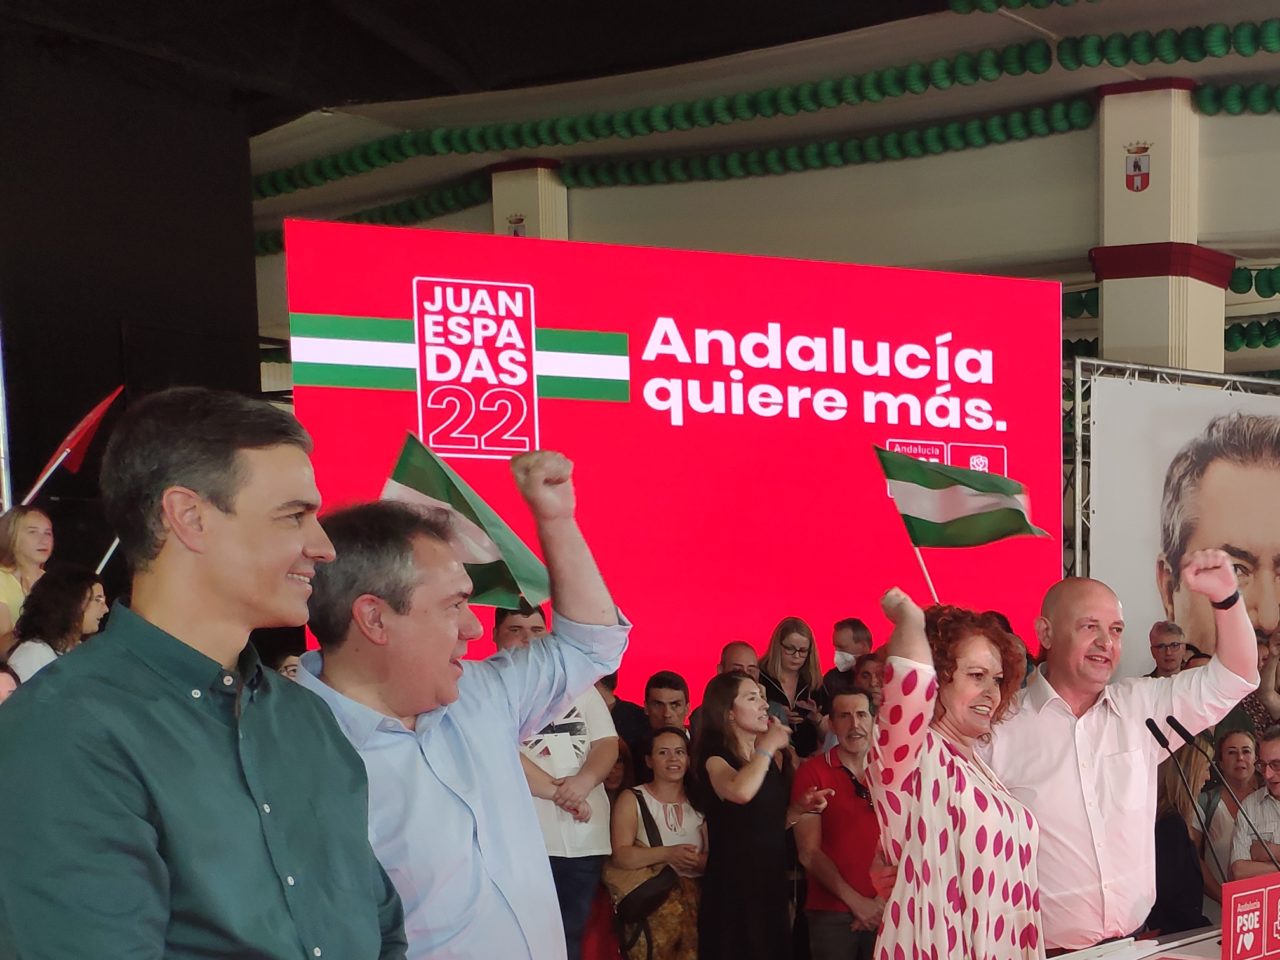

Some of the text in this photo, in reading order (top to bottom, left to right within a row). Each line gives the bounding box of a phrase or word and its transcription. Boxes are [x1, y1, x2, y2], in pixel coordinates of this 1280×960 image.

[423, 286, 524, 317] JUAN
[424, 314, 525, 349] ESPA
[641, 317, 993, 384] Andalucía
[425, 345, 528, 386] DAS
[427, 385, 529, 451] 22
[643, 369, 1007, 432] quiere más.
[1237, 911, 1260, 933] PSOE
